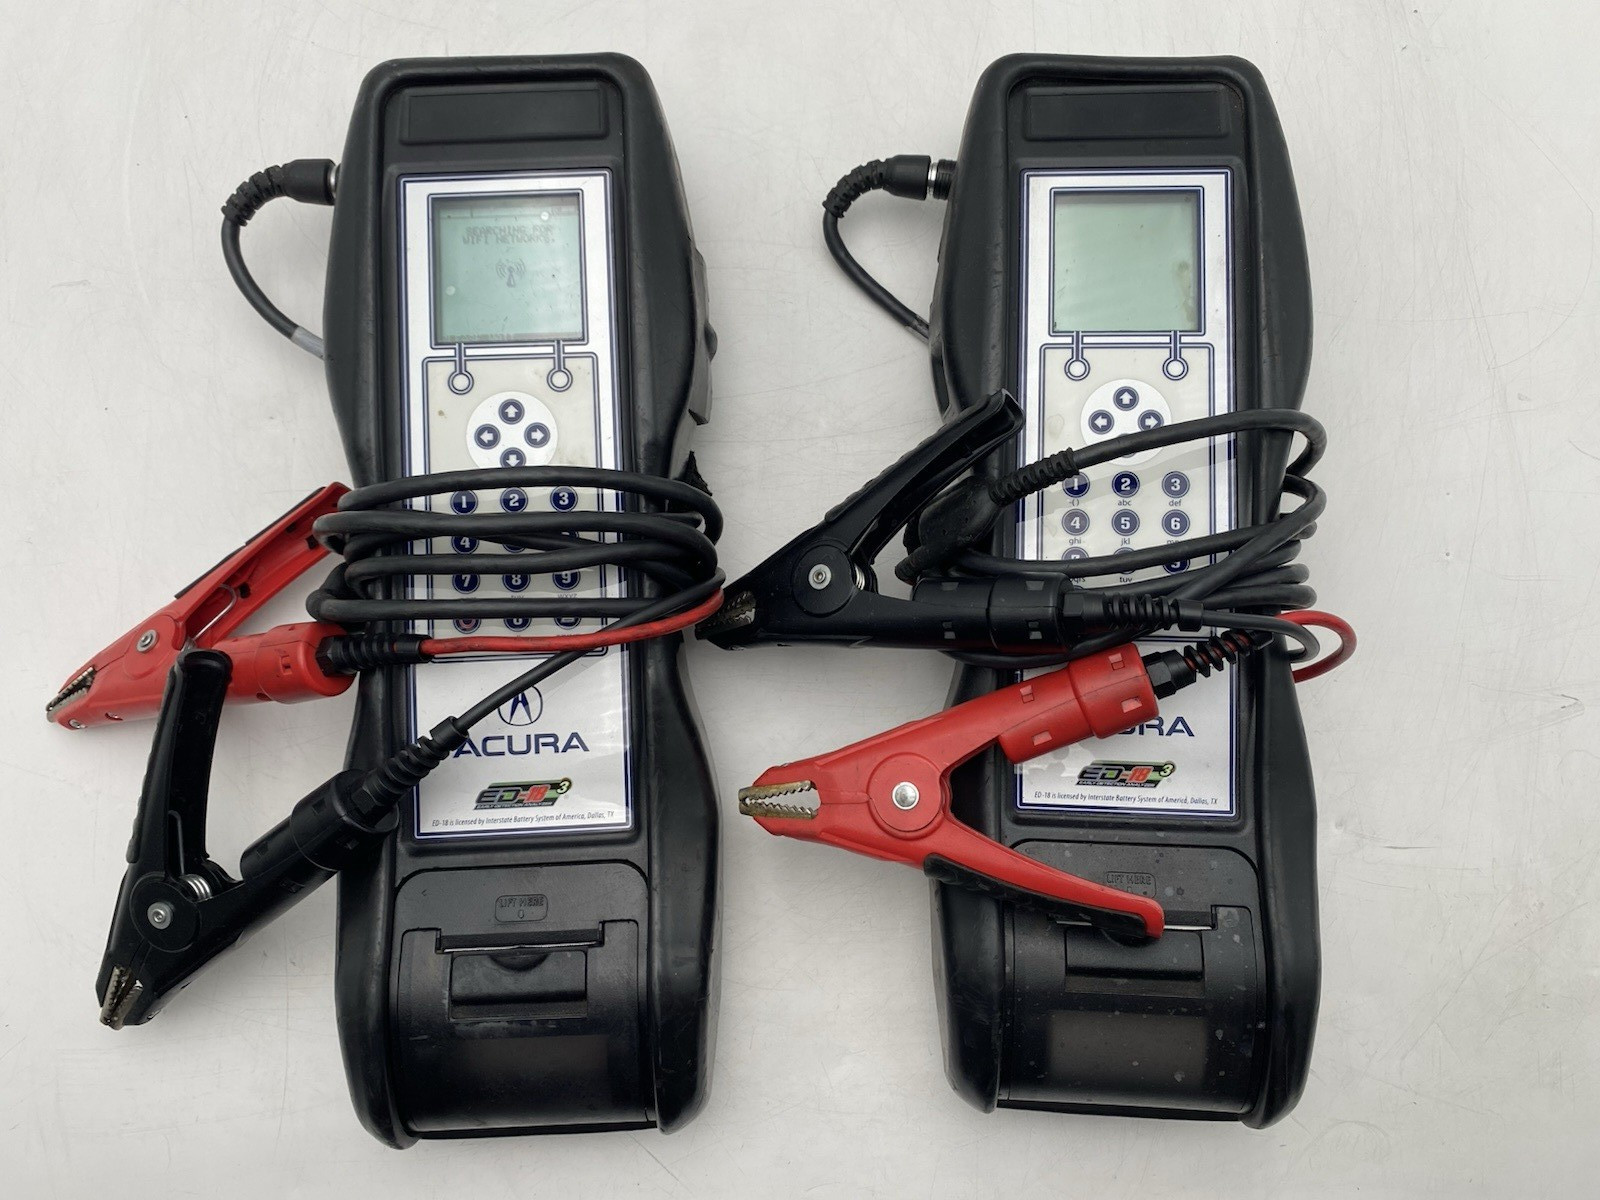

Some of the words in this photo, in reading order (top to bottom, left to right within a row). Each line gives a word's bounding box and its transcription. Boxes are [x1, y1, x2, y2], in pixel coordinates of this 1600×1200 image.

[1073, 479, 1079, 490] 1
[1120, 478, 1131, 491] 2
[1171, 478, 1181, 491] 3
[462, 496, 468, 508] 1
[509, 494, 519, 506] 2
[559, 492, 569, 505] 3
[1070, 516, 1081, 529] 4
[1121, 517, 1130, 530] 5
[1171, 518, 1181, 530] 6
[460, 537, 470, 548] 4
[1068, 538, 1082, 546] ghi
[1120, 538, 1131, 546] jkl
[462, 574, 471, 587] 7
[511, 574, 522, 586] 8
[562, 571, 571, 584] 9
[453, 732, 590, 758] ACURA
[1160, 764, 1174, 777] 3
[556, 781, 570, 794] 3
[1034, 791, 1051, 799] ED-18
[1057, 792, 1080, 800] licensed
[1080, 793, 1087, 801] by
[1088, 793, 1114, 801] Interstate
[1116, 794, 1137, 803] Battery
[1137, 795, 1157, 803] System
[1165, 796, 1189, 805] America,
[1190, 797, 1209, 805] Dallas,
[455, 818, 477, 826] licensed
[535, 814, 554, 823] System
[587, 811, 606, 819] Dallas,
[1126, 874, 1152, 885] HERE
